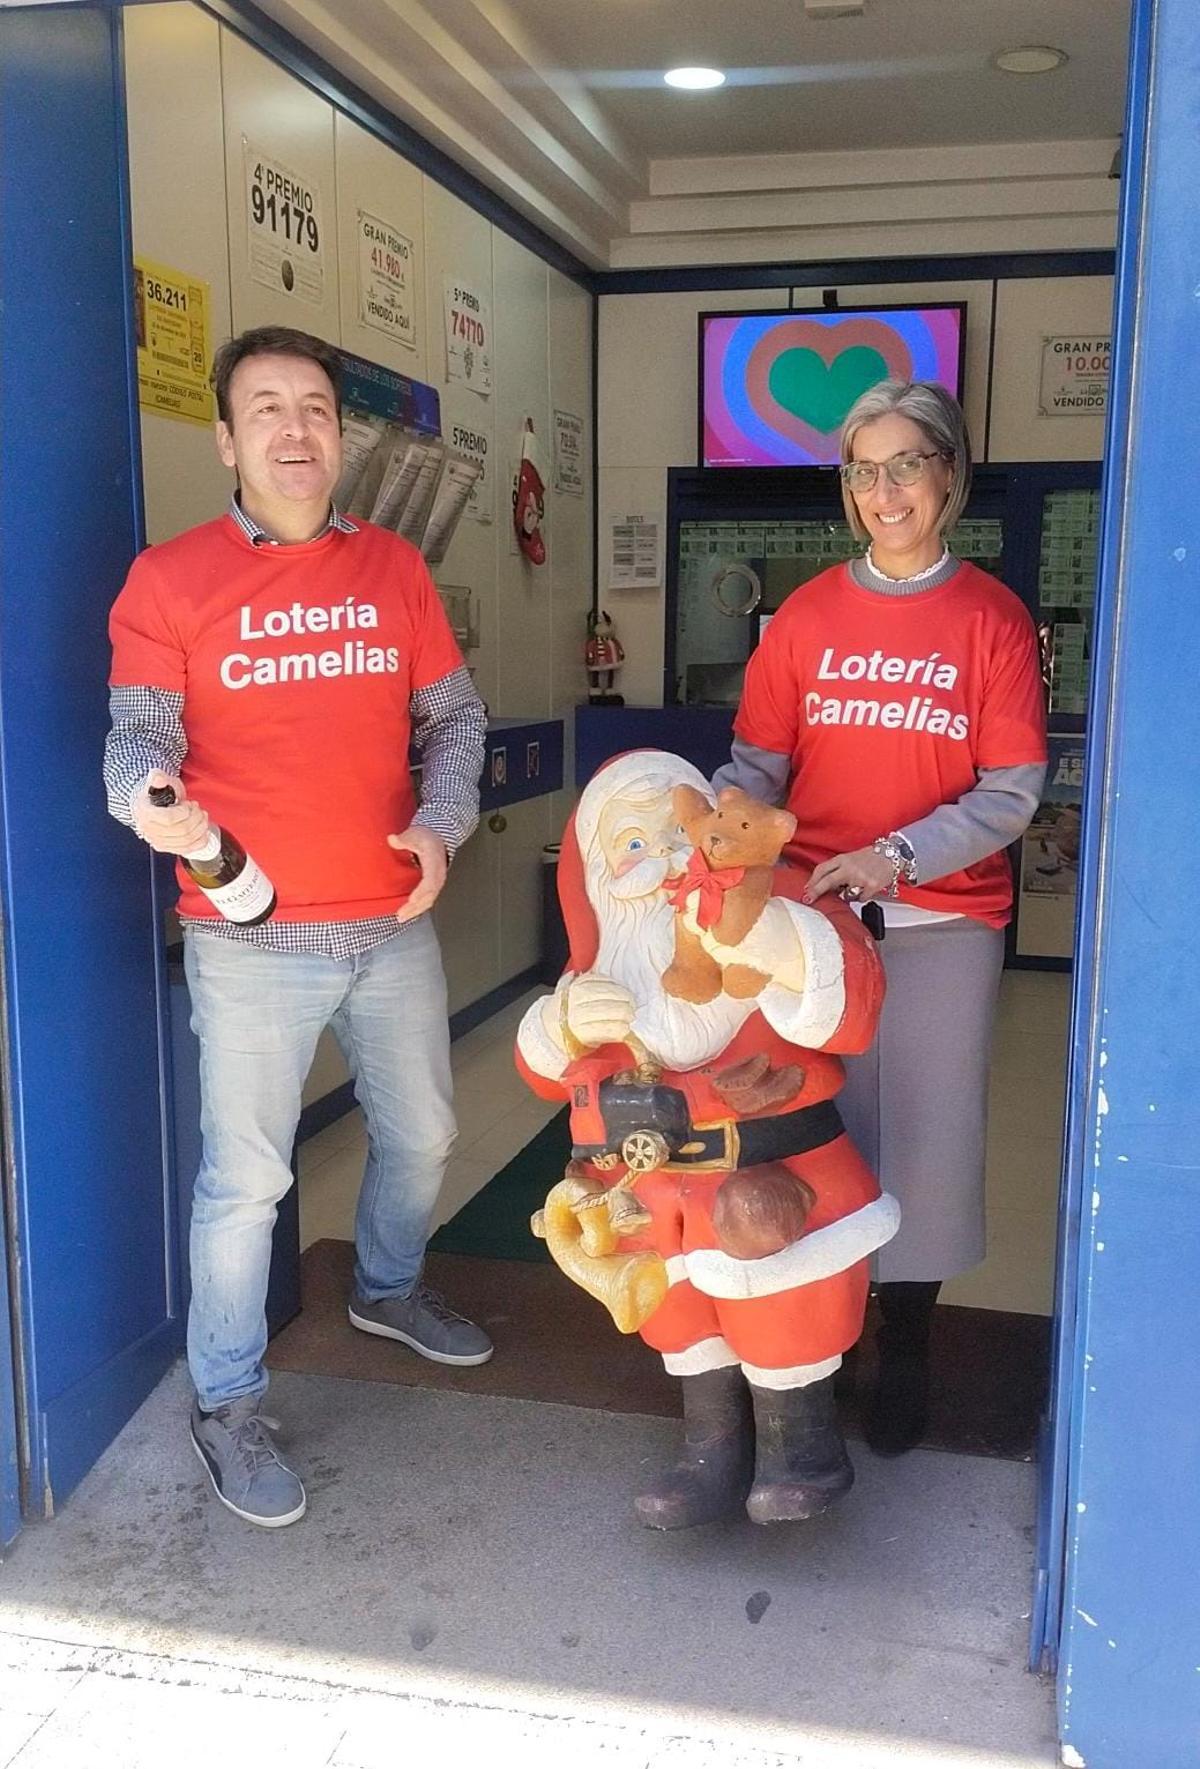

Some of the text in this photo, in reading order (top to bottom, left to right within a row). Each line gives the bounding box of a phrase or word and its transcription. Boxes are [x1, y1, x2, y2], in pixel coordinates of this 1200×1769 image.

[266, 168, 313, 214] PREMIO
[251, 183, 319, 253] 91179
[363, 222, 387, 246] GRAN
[146, 279, 187, 313] 36.211
[366, 299, 394, 323] VENDIDO
[451, 309, 485, 347] 74770
[1053, 341, 1092, 354] GRAN
[1053, 396, 1105, 407] VENDIDO
[459, 428, 487, 455] PREMIO
[240, 596, 379, 641] Lotería
[220, 640, 399, 690] Camelias
[817, 648, 958, 690] Lotería
[805, 691, 969, 741] Camelias
